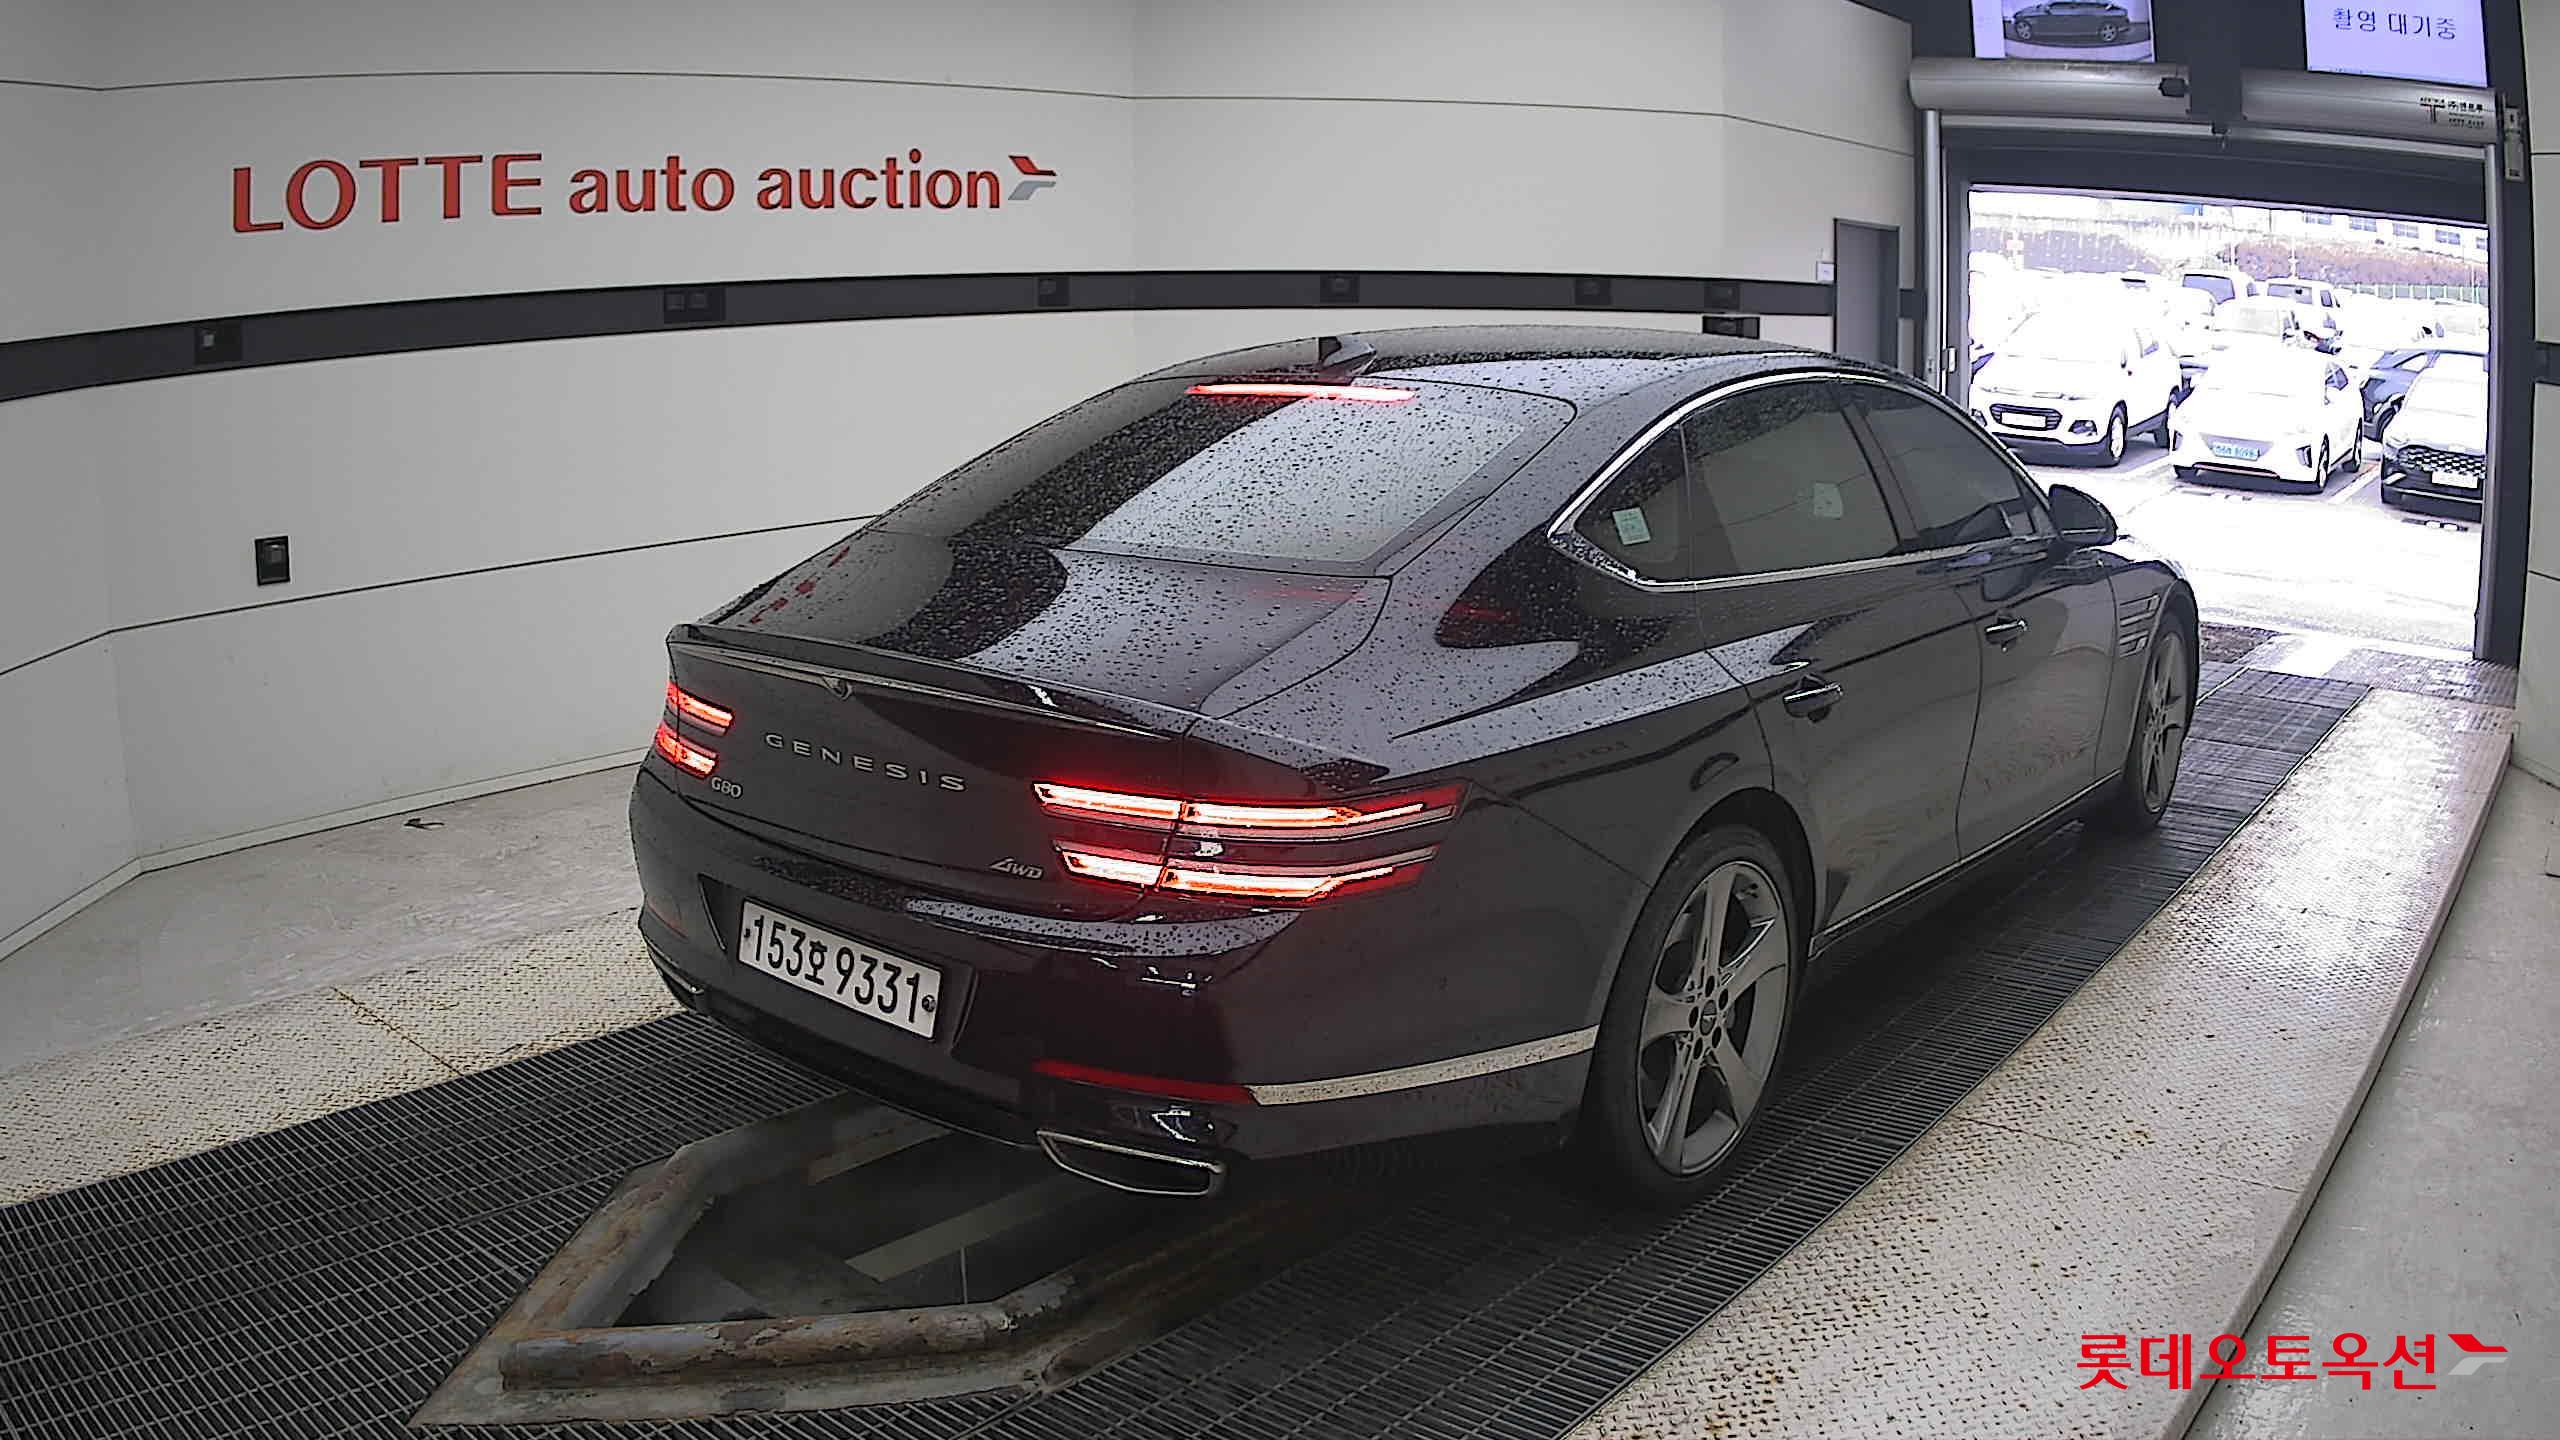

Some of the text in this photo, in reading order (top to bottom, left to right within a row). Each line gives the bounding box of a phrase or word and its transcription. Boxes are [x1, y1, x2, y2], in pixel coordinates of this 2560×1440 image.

[2333, 8, 2456, 40] 촬영 대기중
[233, 148, 1001, 233] LOTTE auto auction
[765, 733, 967, 792] GENESIS
[711, 775, 743, 799] G80
